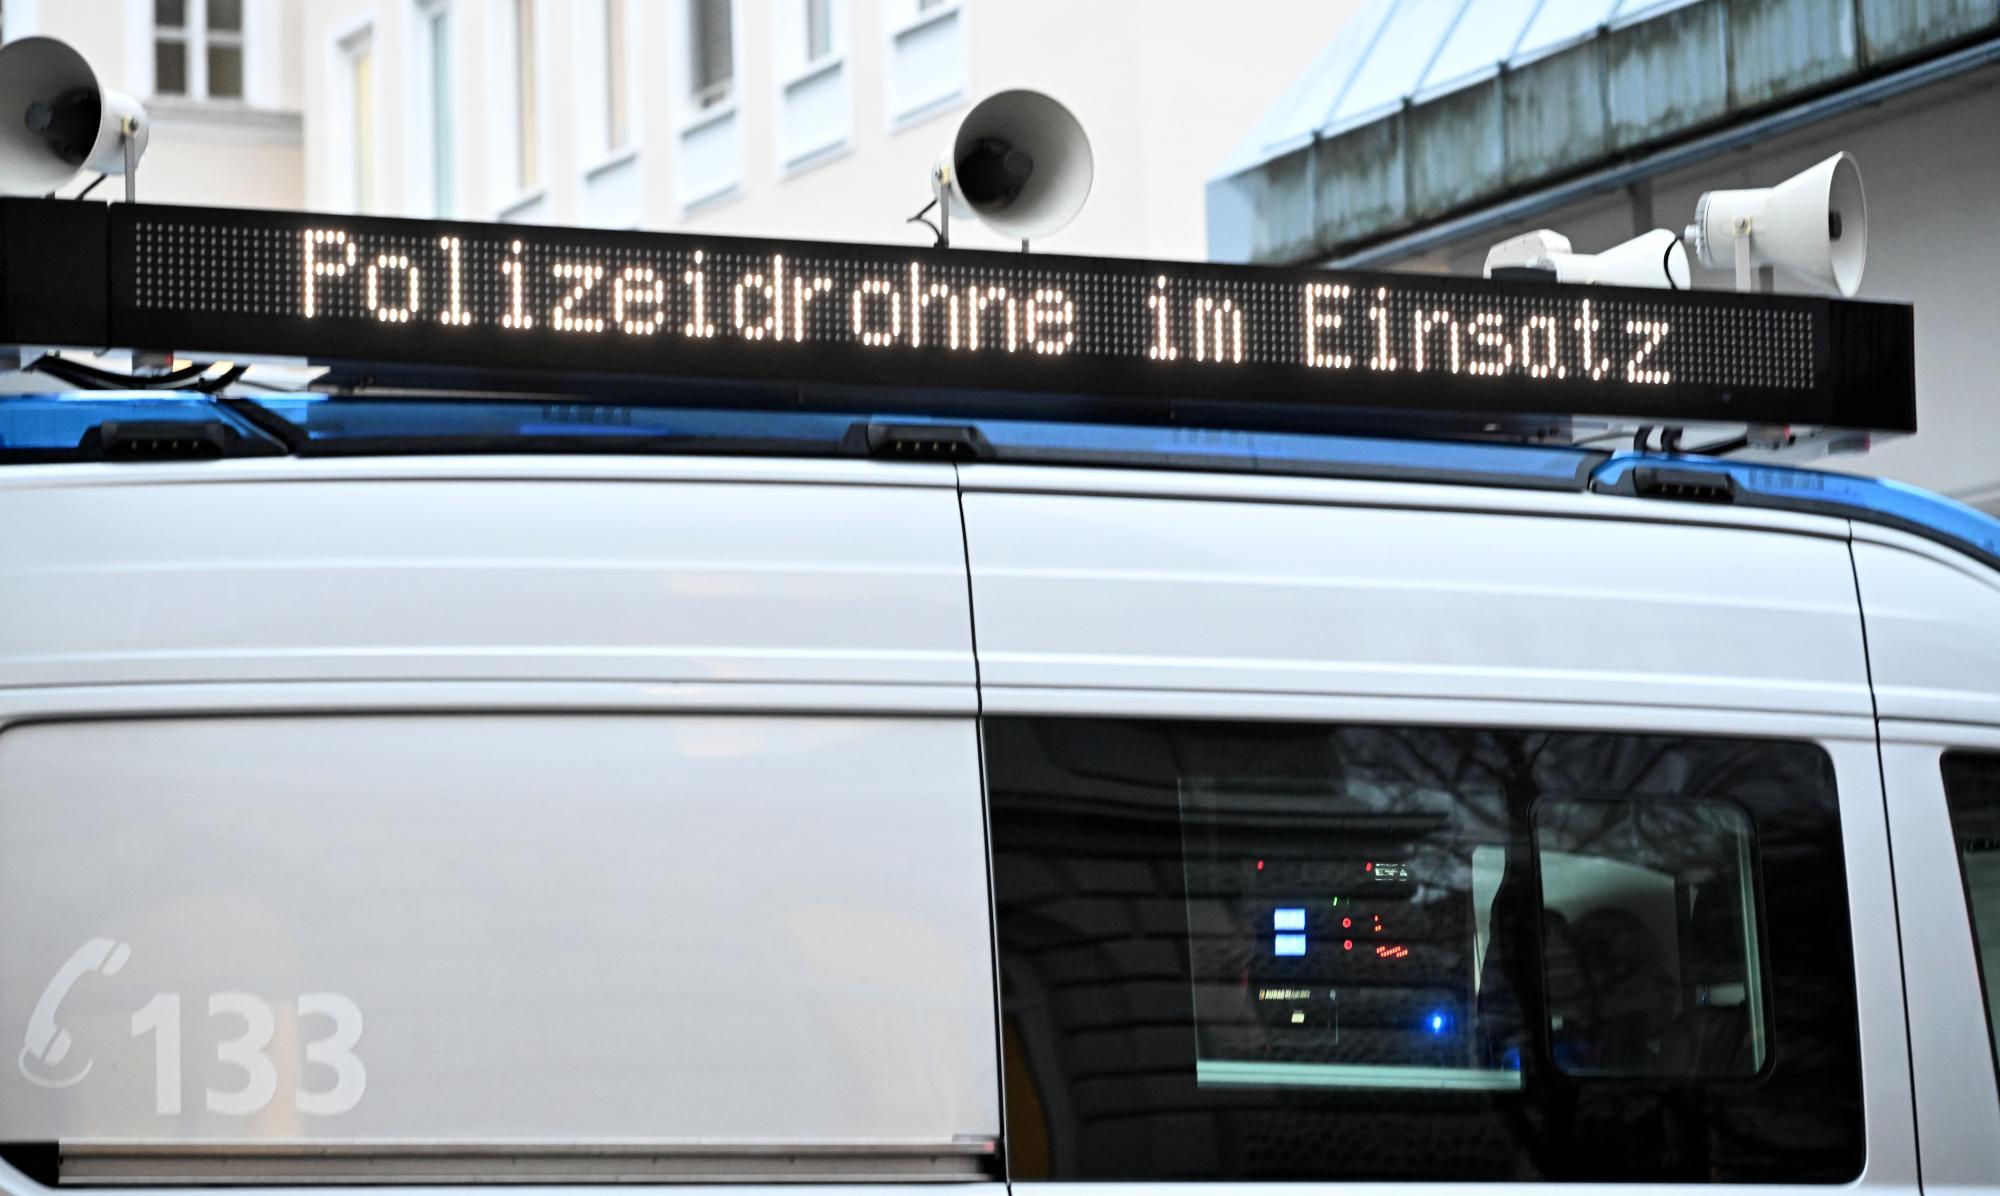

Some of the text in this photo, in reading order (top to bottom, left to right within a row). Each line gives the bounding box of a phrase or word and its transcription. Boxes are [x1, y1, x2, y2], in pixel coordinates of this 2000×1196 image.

[303, 228, 1671, 385] Polizeidrohne im Einsatz
[131, 993, 367, 1116] 133
